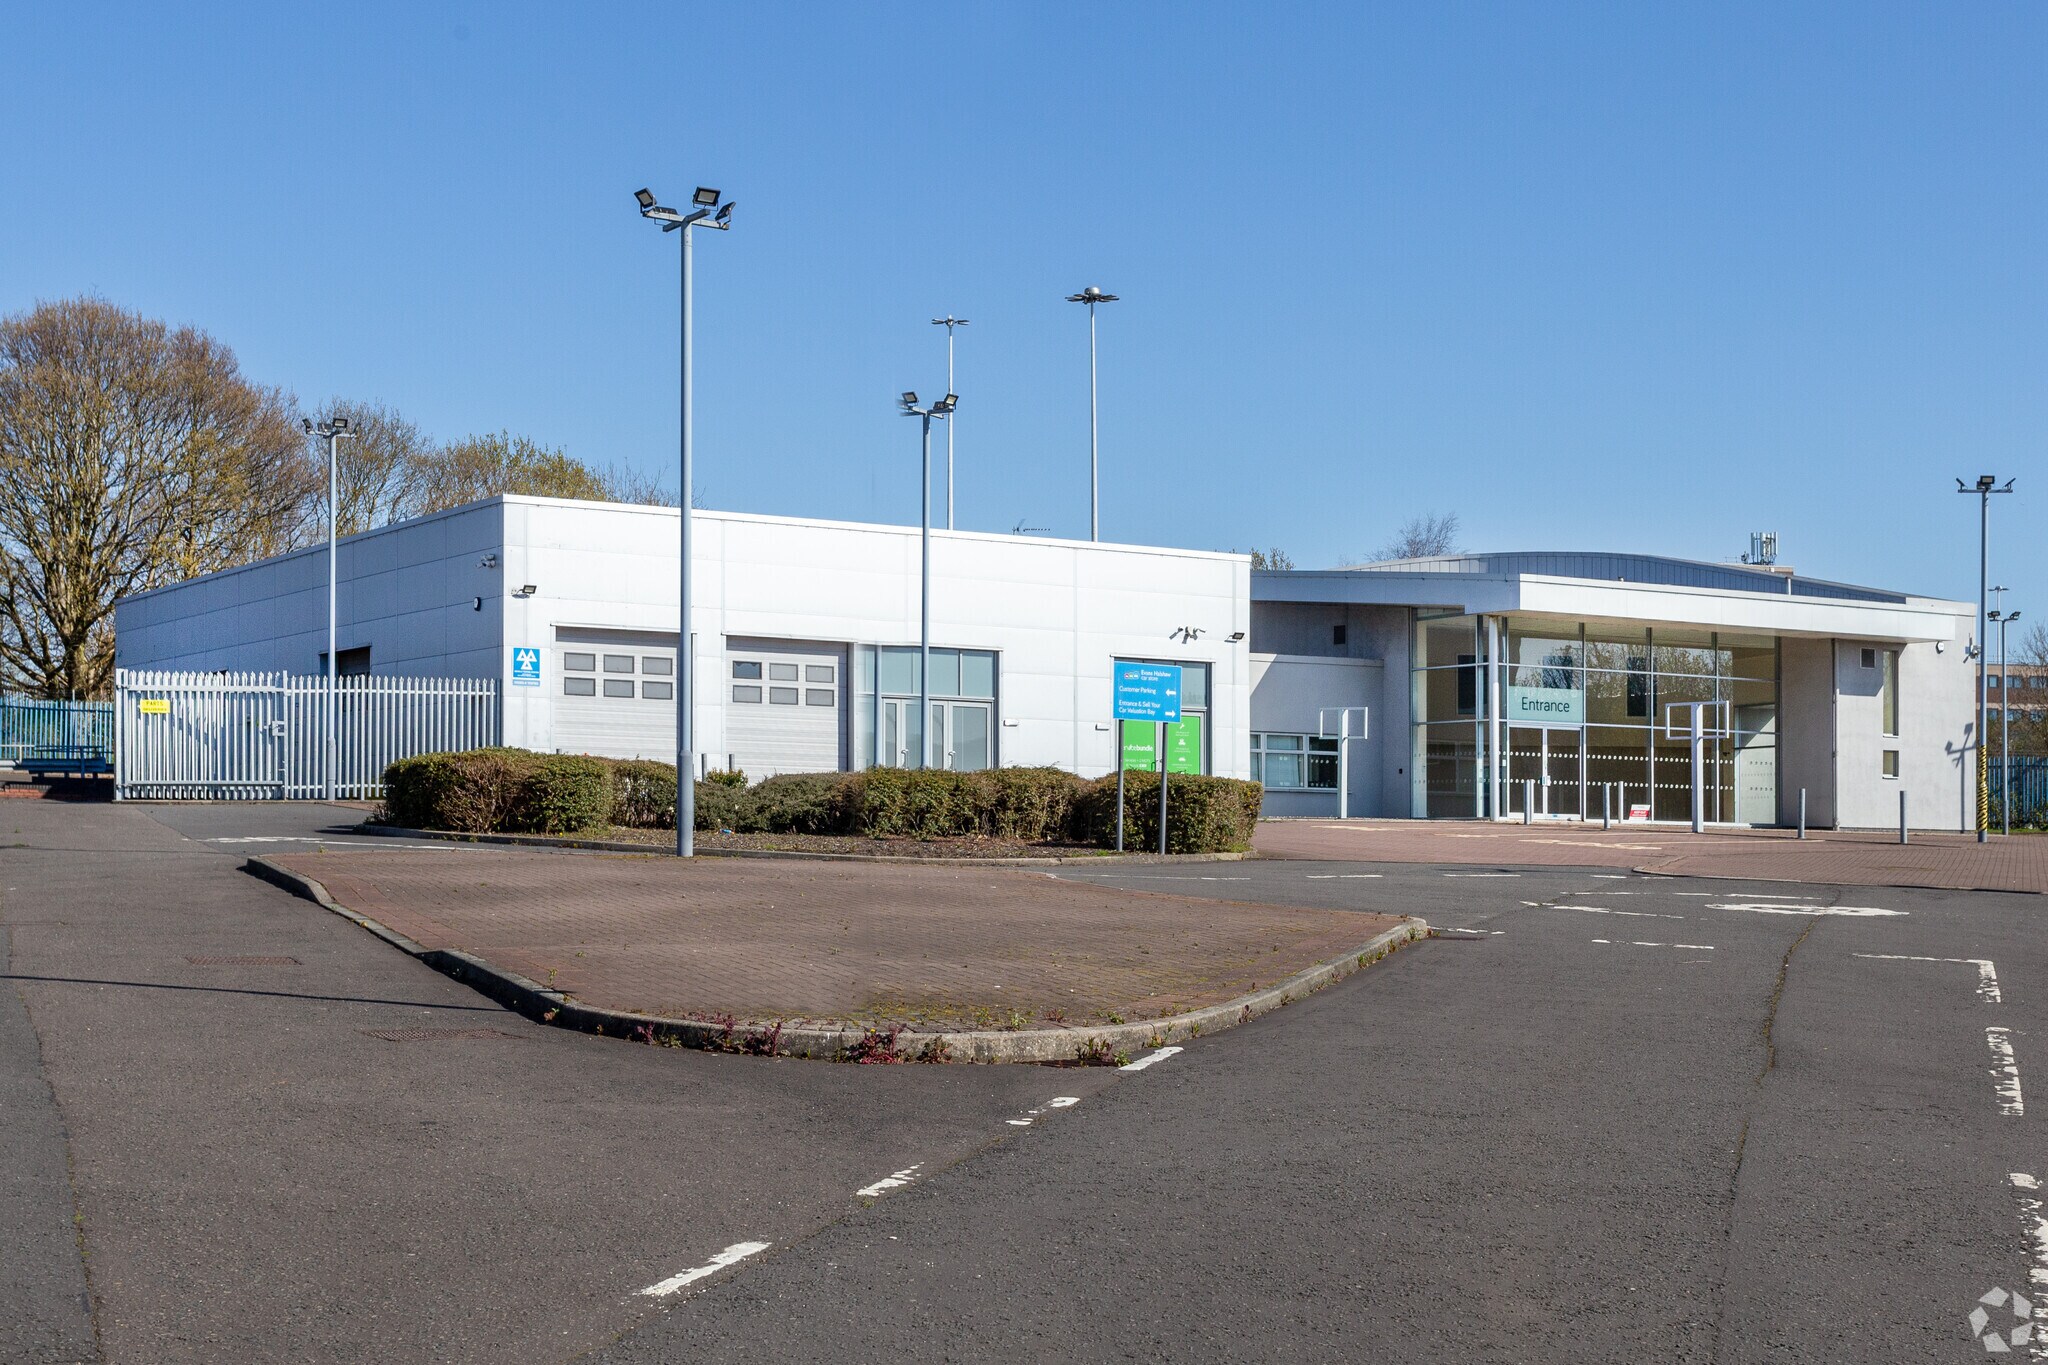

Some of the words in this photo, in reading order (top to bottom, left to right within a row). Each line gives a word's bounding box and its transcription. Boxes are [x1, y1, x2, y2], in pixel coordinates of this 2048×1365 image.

[1140, 687, 1156, 695] Parking
[1521, 696, 1570, 713] Entrance
[1147, 708, 1155, 716] Bay
